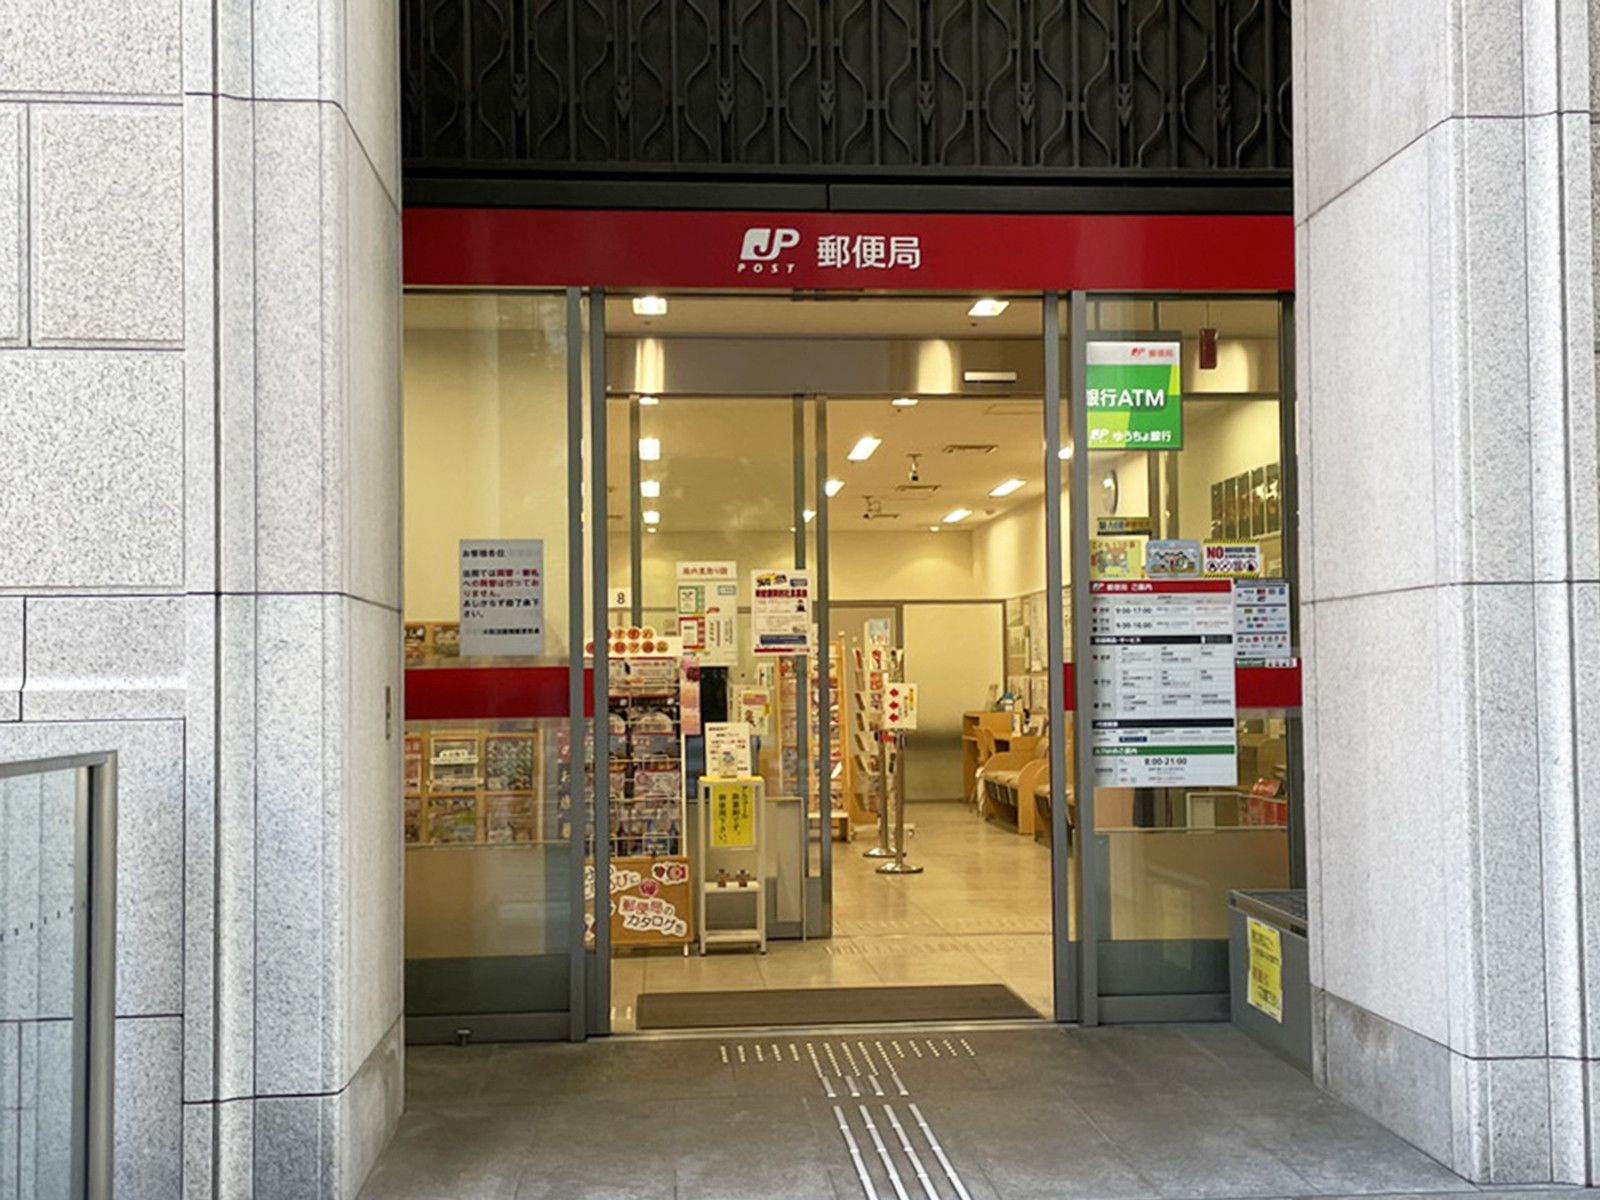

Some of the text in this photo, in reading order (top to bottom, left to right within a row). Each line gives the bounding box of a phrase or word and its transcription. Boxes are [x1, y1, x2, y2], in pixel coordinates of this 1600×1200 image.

[817, 235, 921, 269] 郵便局
[737, 263, 795, 273] POST
[1112, 430, 1172, 442] ゆうちょ銀行
[1207, 546, 1223, 559] NO
[617, 592, 625, 605] 8
